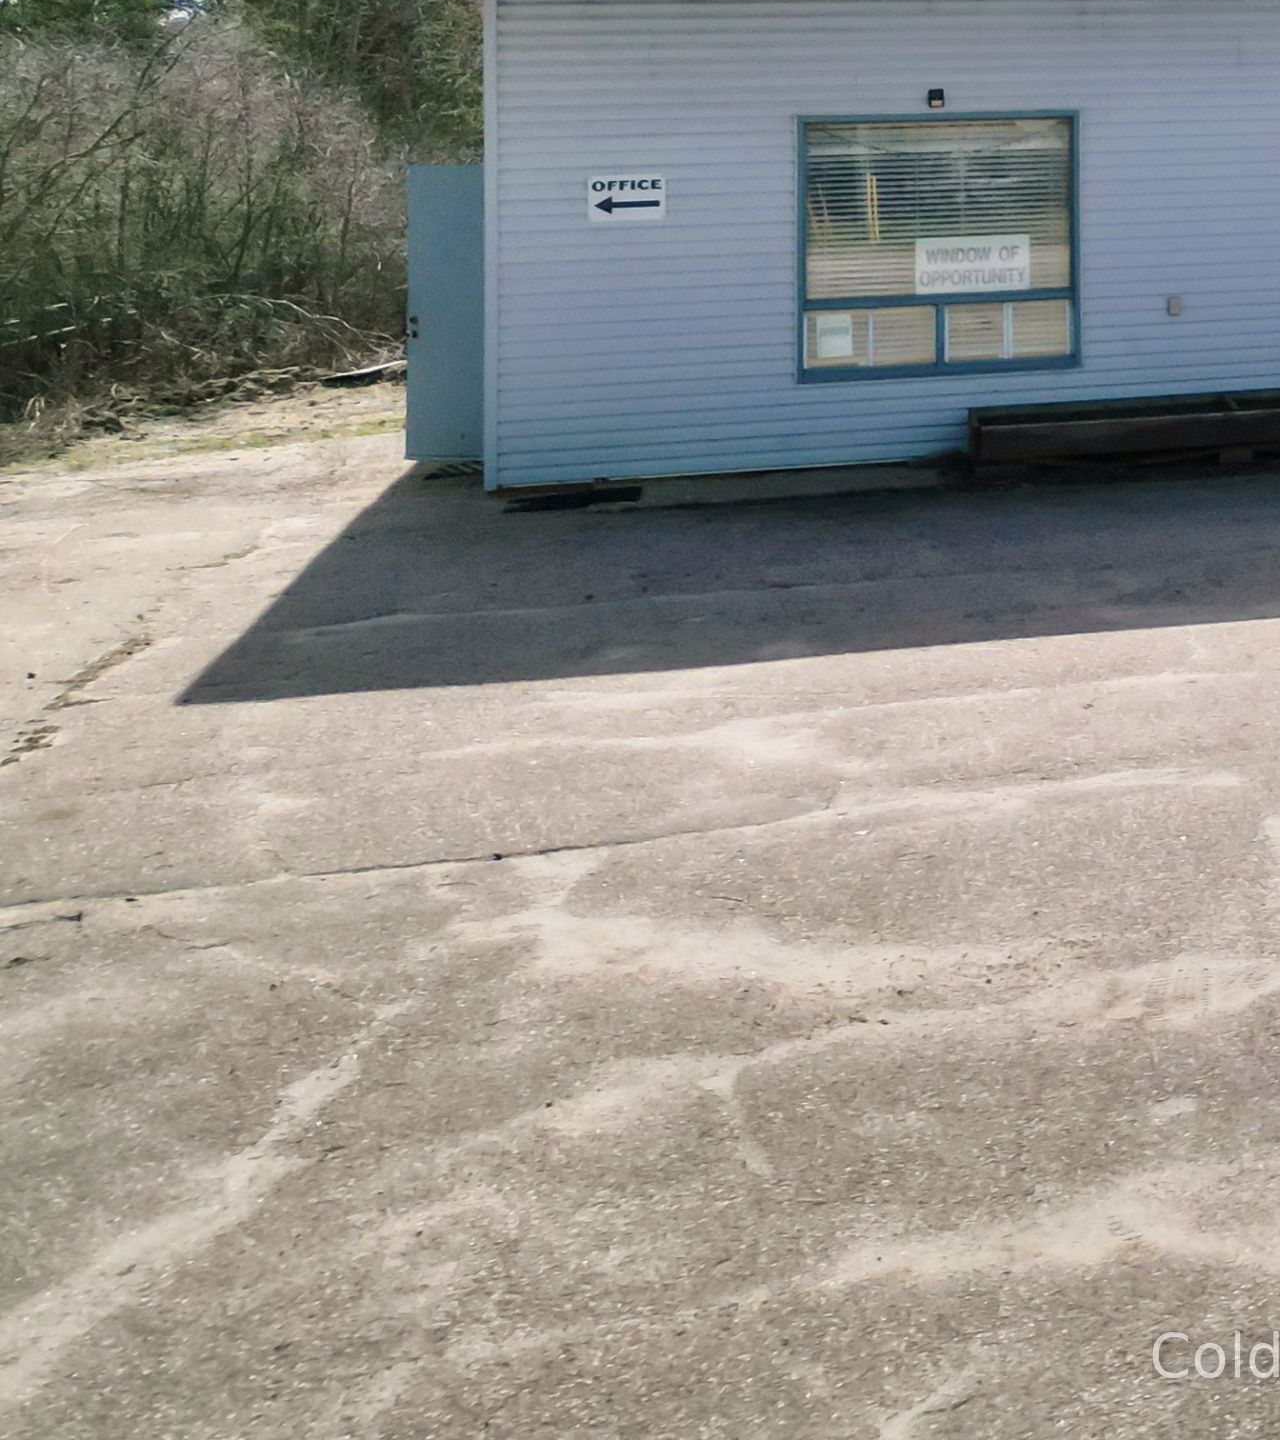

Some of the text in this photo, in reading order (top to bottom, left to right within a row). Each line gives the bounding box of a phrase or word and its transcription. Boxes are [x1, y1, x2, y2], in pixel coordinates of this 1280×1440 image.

[591, 179, 662, 192] OFFICE
[925, 245, 1020, 265] WINDOW OF
[919, 267, 1026, 288] OPPORTUNITY
